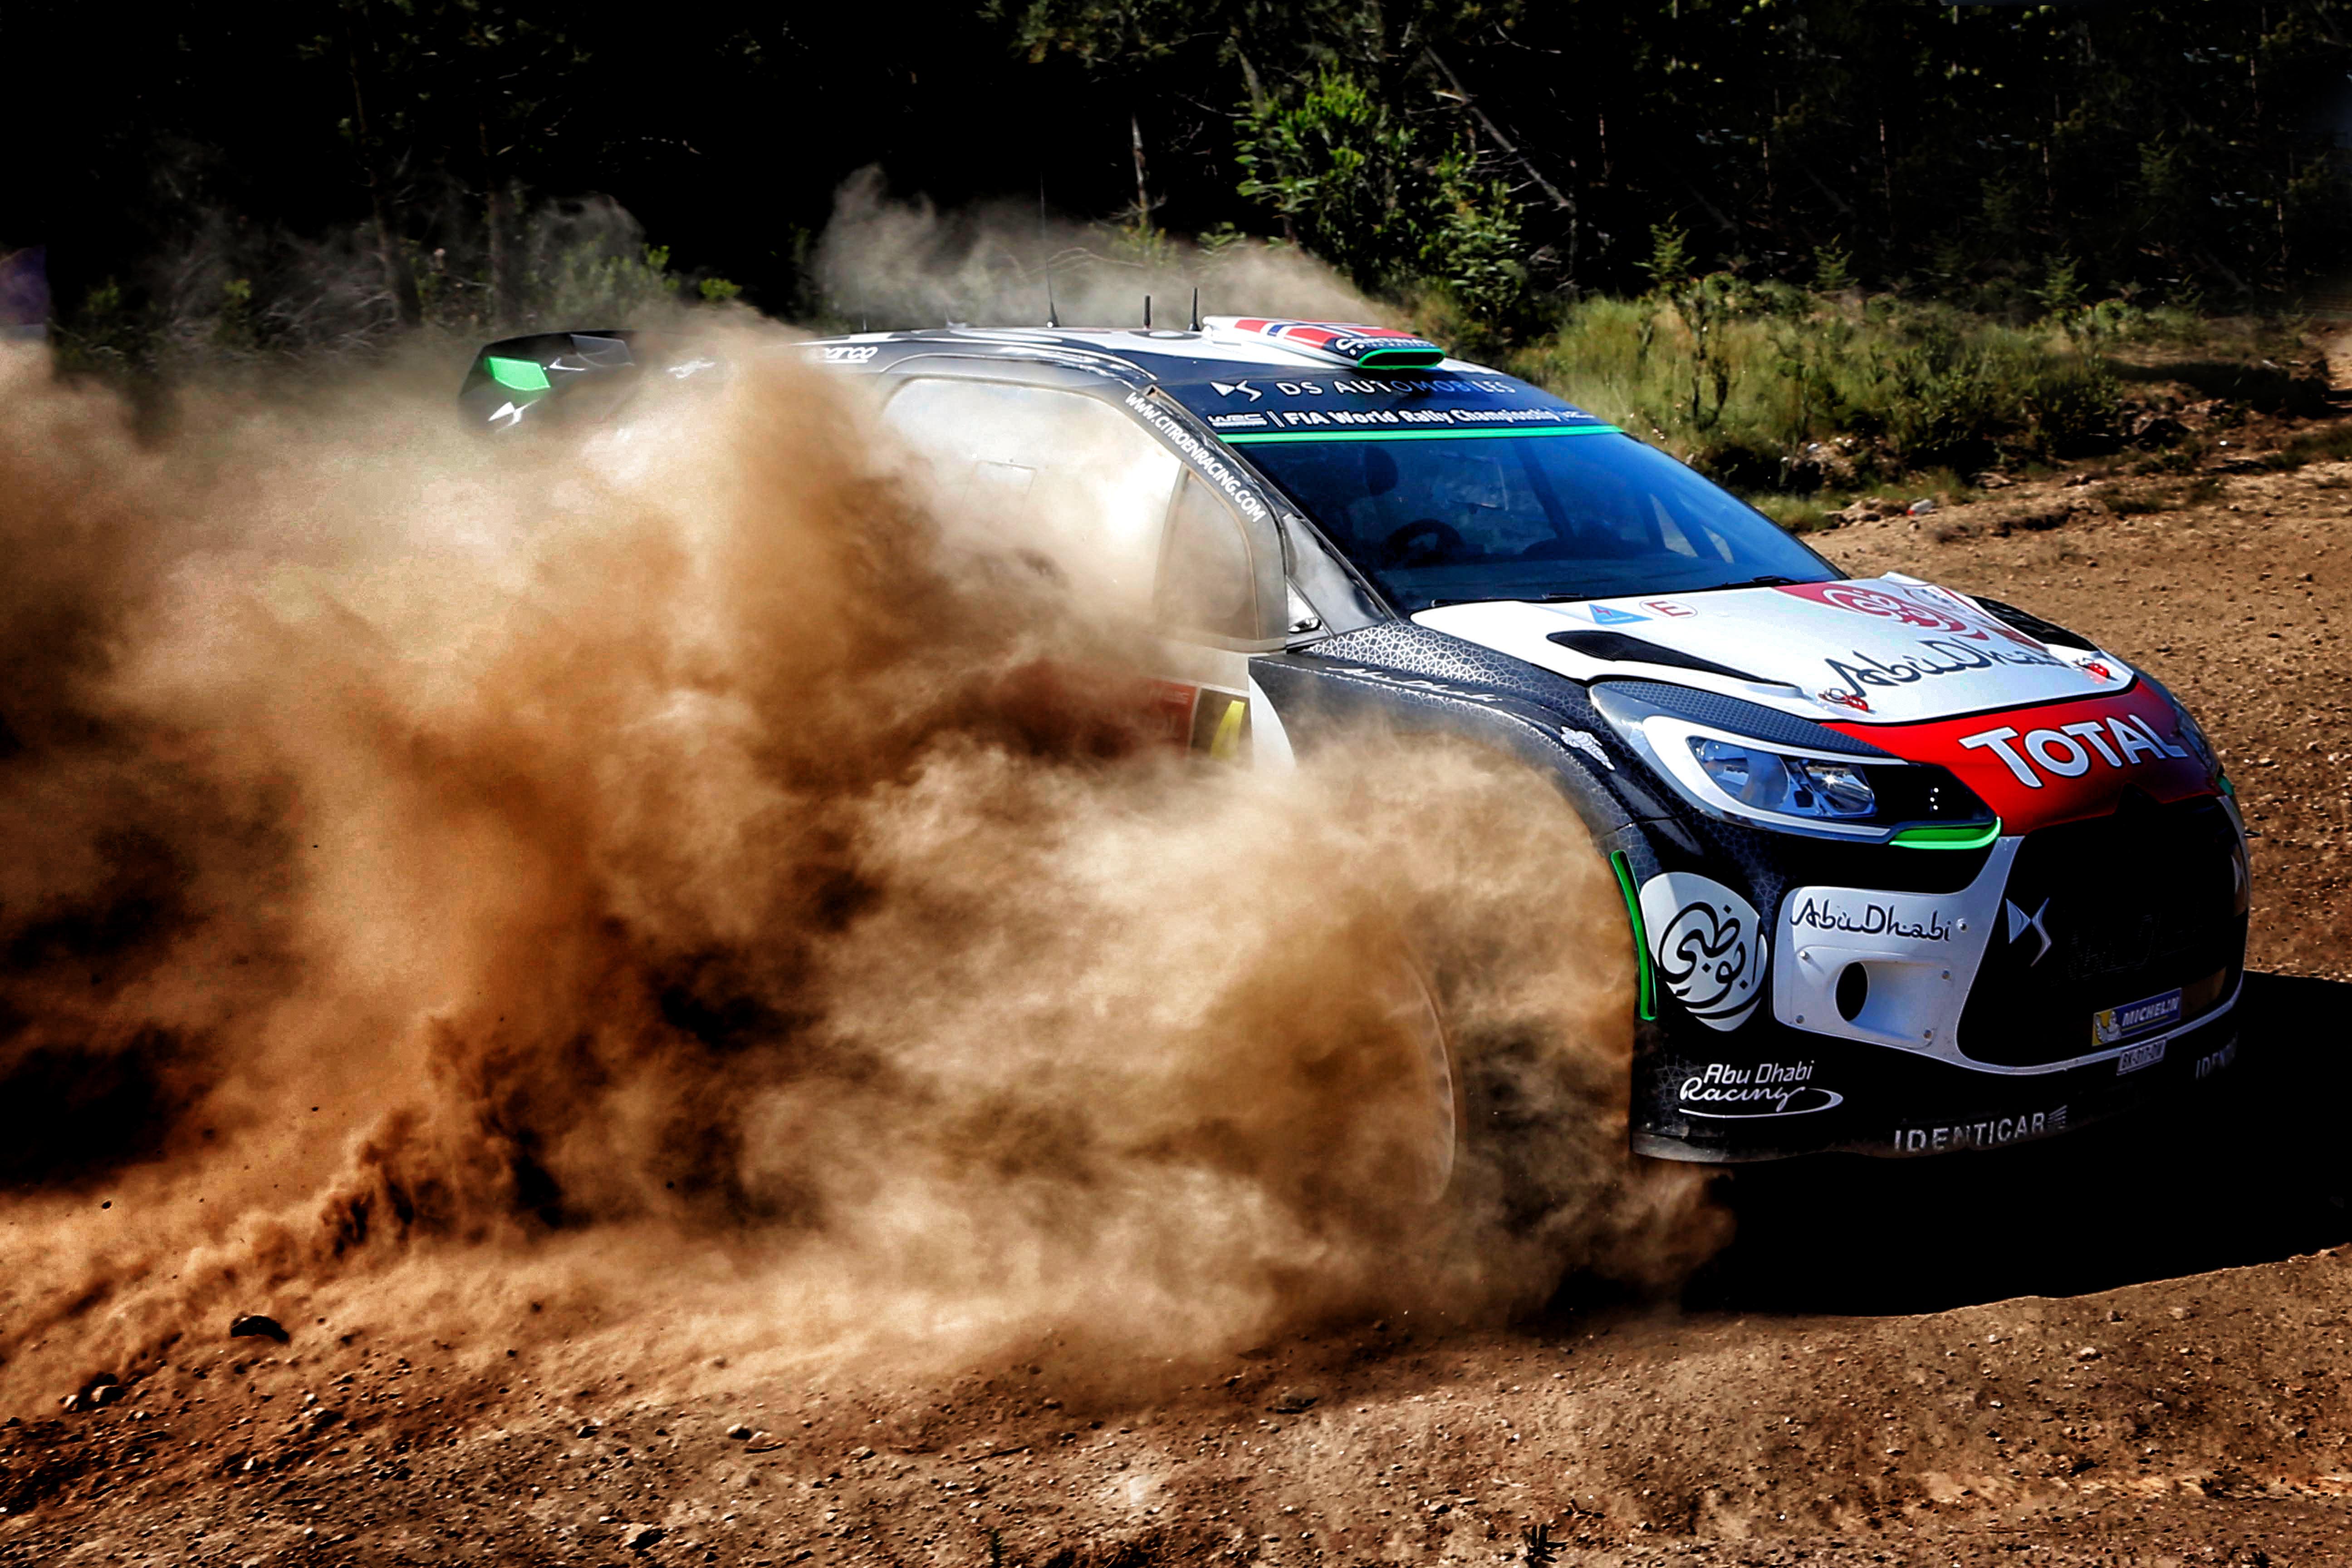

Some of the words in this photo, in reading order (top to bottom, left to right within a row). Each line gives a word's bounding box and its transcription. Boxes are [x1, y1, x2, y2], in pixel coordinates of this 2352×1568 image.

[1276, 382, 1324, 395] DS
[1333, 380, 1516, 394] AUTOMOBILES
[1283, 411, 1331, 425] FIA
[1328, 410, 1399, 424] World
[1399, 410, 1455, 424] Rally
[1450, 409, 1561, 423] Championship
[1644, 601, 1694, 617] E
[1959, 714, 2189, 788] TOTAL
[2122, 996, 2181, 1028] MICHELIN
[1703, 1063, 1751, 1084] Abu
[1754, 1060, 1815, 1084] Dhabi
[1680, 1077, 1806, 1112] Racing
[1893, 1111, 2047, 1153] IDENTICAR
